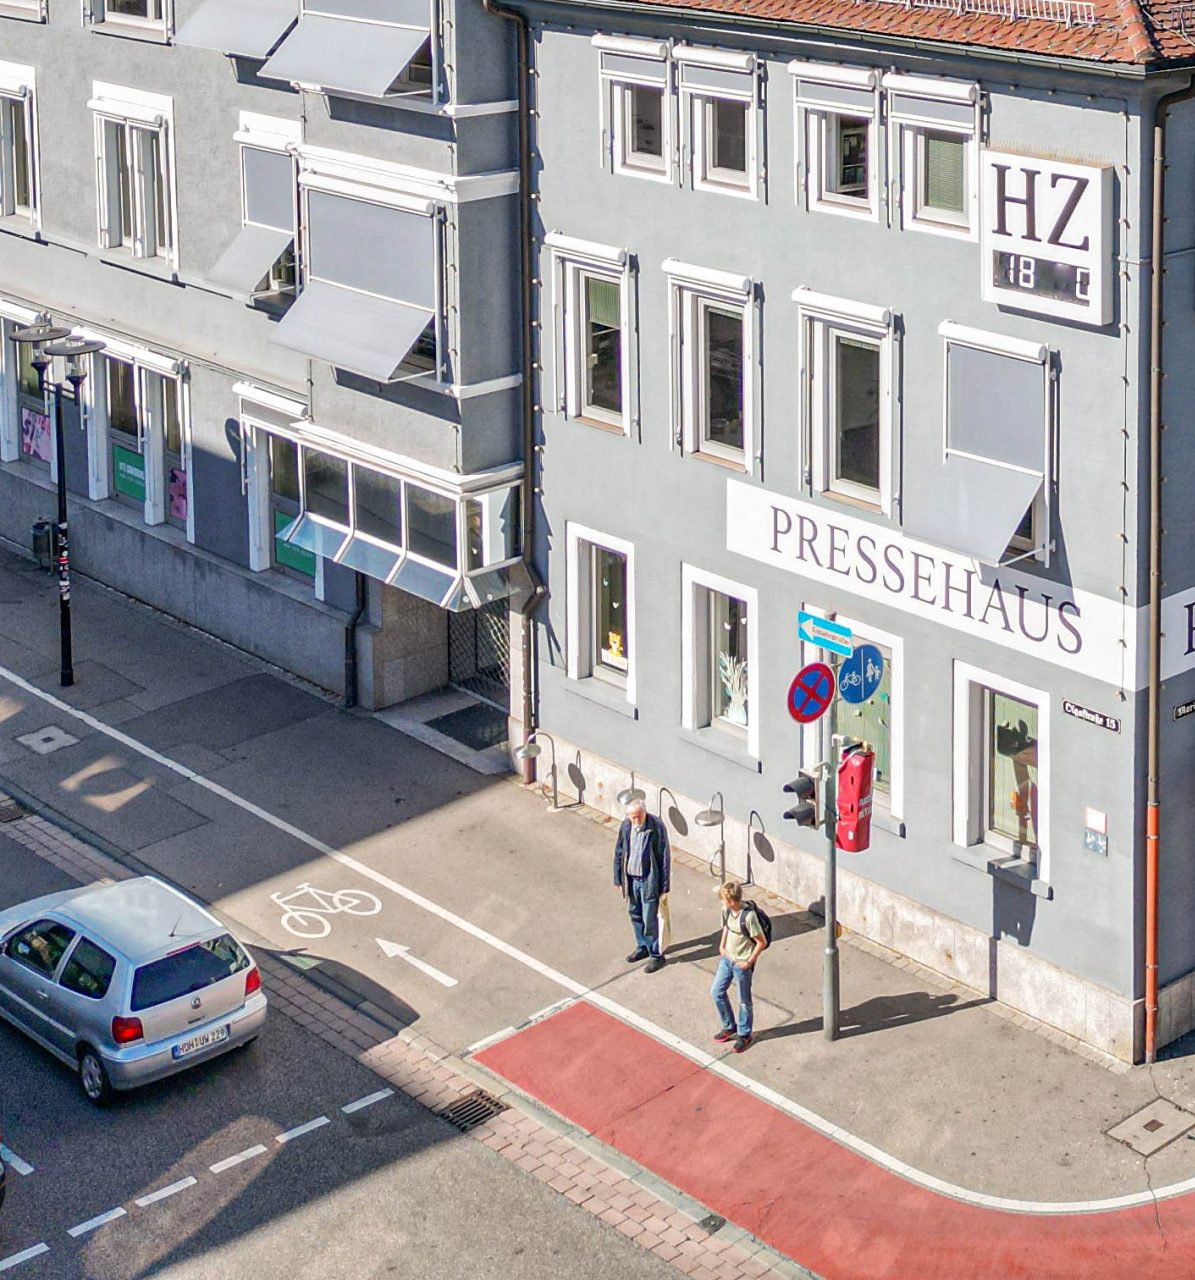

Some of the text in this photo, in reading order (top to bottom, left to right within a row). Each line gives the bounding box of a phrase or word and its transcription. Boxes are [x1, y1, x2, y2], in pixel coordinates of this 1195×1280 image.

[992, 163, 1089, 251] HZ
[1009, 254, 1035, 289] 18
[769, 505, 1083, 655] PRESSEHAUS
